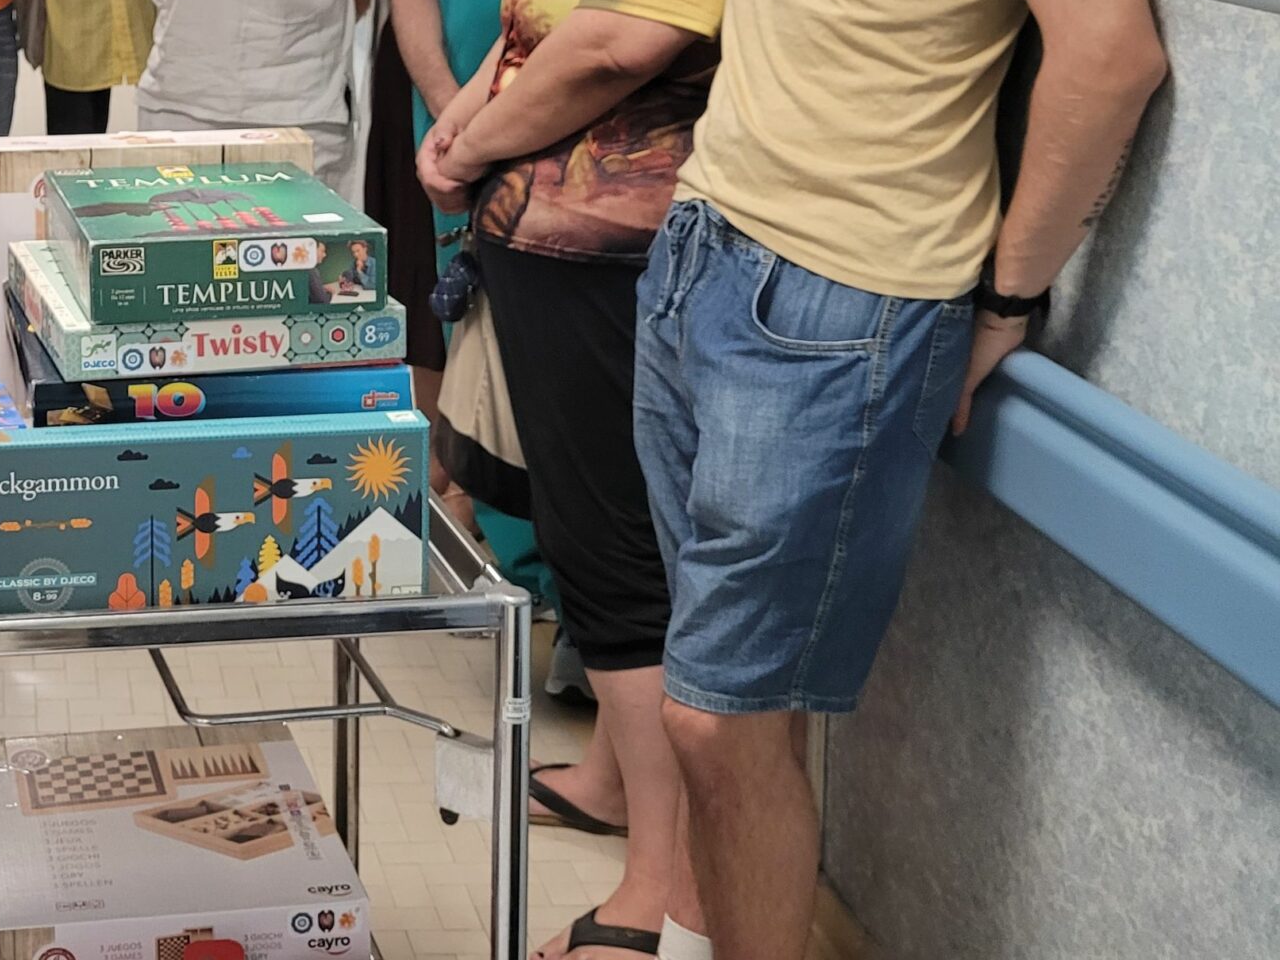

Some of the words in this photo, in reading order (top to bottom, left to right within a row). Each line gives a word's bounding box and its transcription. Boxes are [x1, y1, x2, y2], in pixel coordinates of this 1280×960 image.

[76, 172, 294, 188] TEMPLUM
[102, 249, 142, 259] PARKER
[156, 279, 296, 306] TEMPLUM
[191, 324, 285, 358] Twisty
[83, 360, 116, 369] DJECO
[127, 381, 207, 420] 10
[43, 577, 58, 586] BY
[60, 575, 96, 585] DJECO
[307, 883, 351, 895] cayro
[307, 935, 350, 952] cayro
